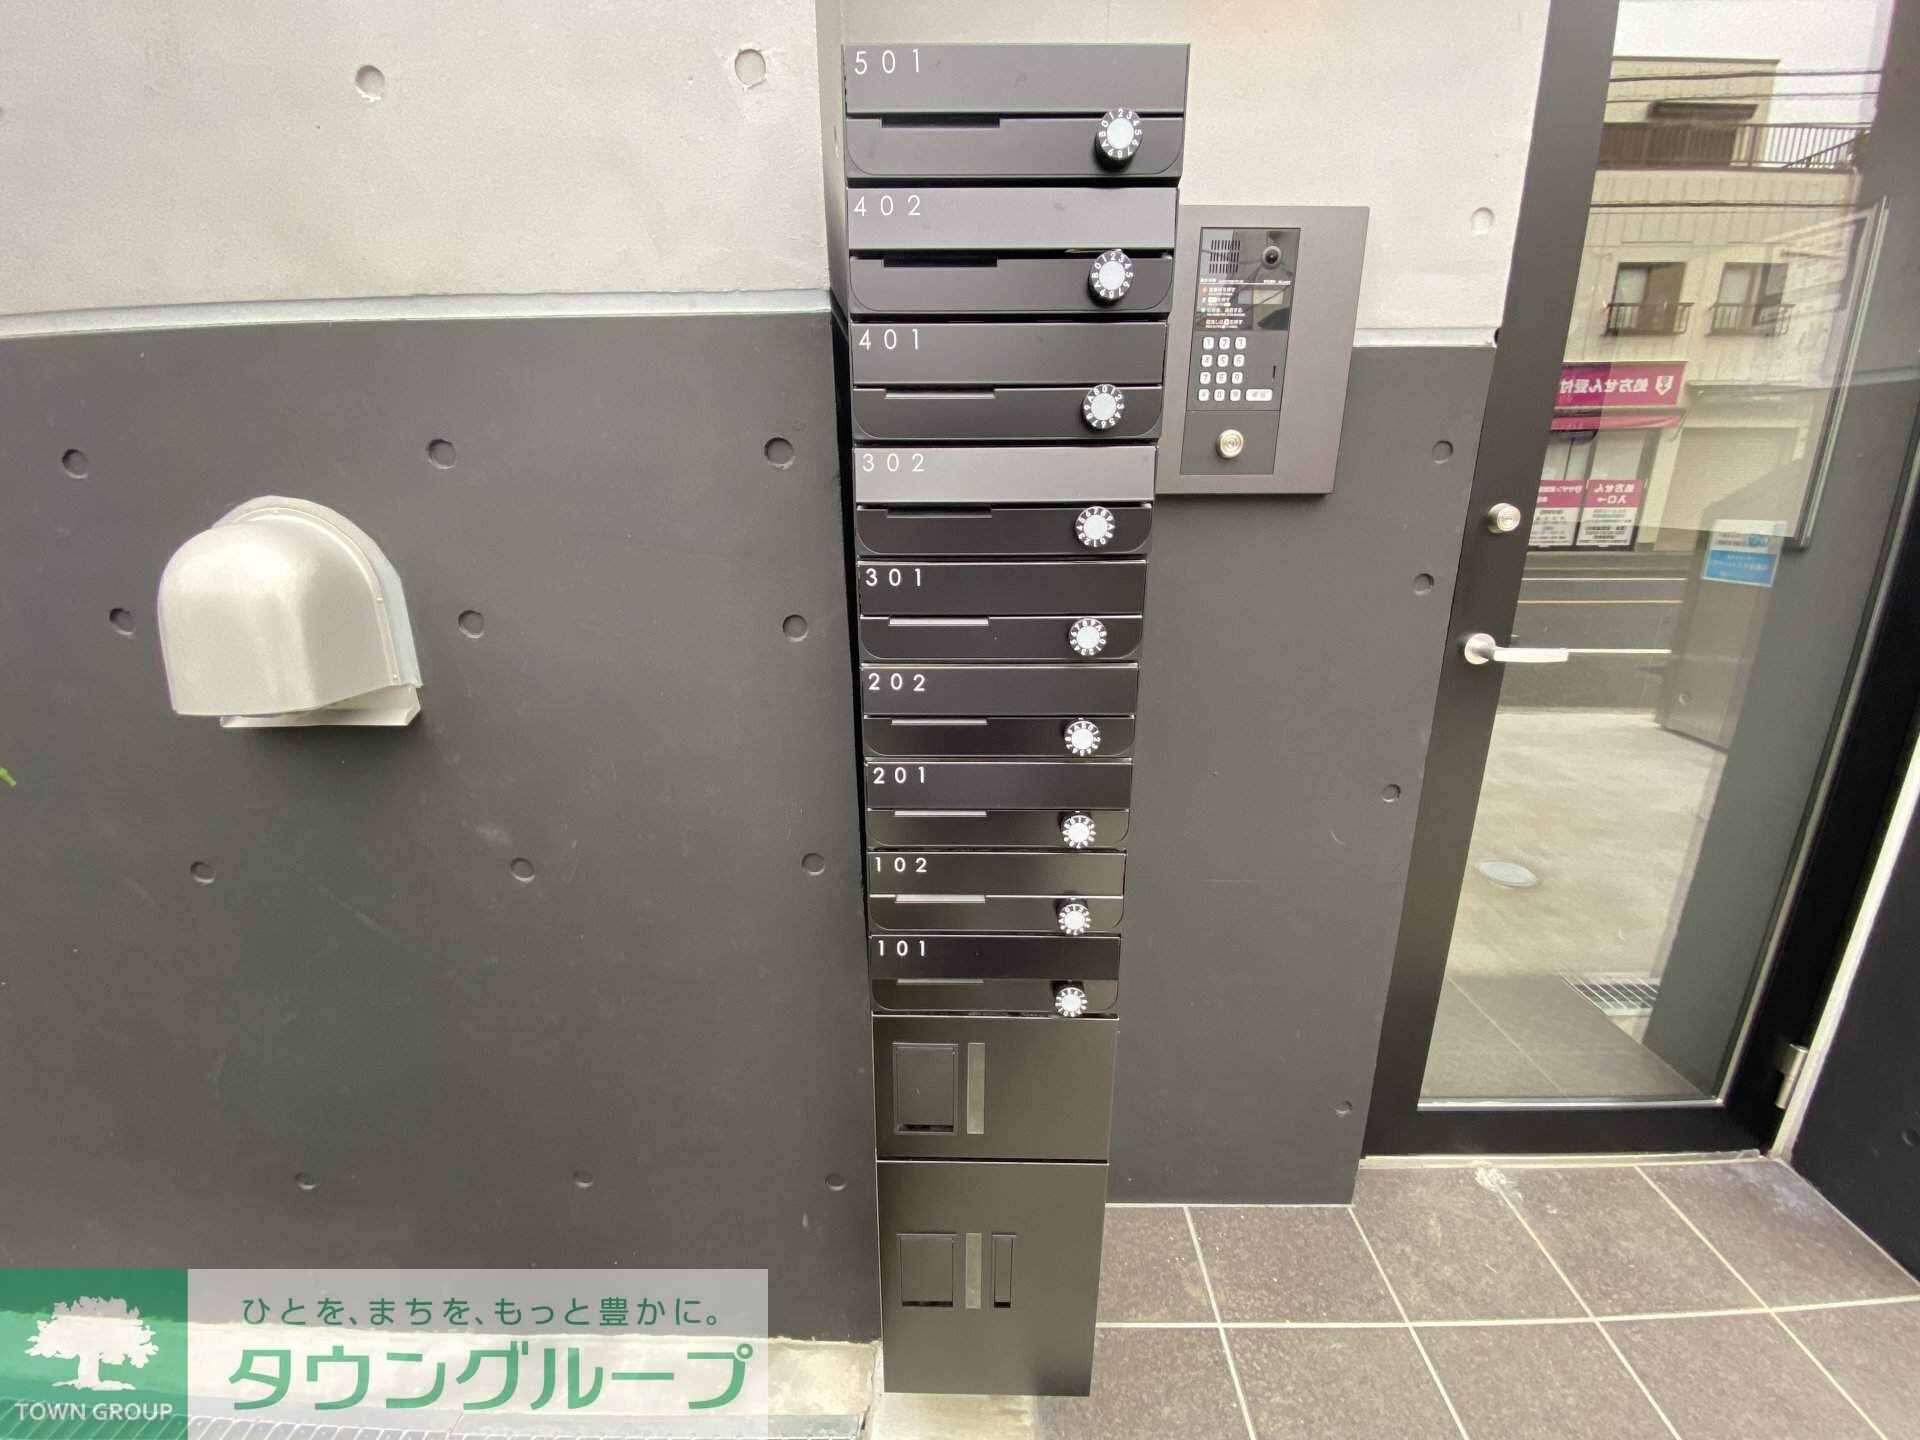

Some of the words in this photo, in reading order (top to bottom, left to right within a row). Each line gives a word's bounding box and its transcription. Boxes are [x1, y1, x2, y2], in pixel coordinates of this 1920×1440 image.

[853, 48, 921, 75] 501
[853, 194, 922, 217] 402
[857, 328, 920, 351] 401
[861, 453, 926, 473] 302
[864, 567, 922, 587] 301
[867, 672, 926, 692] 202
[872, 766, 926, 785] 201
[874, 856, 928, 874] 102
[877, 939, 927, 957] 101
